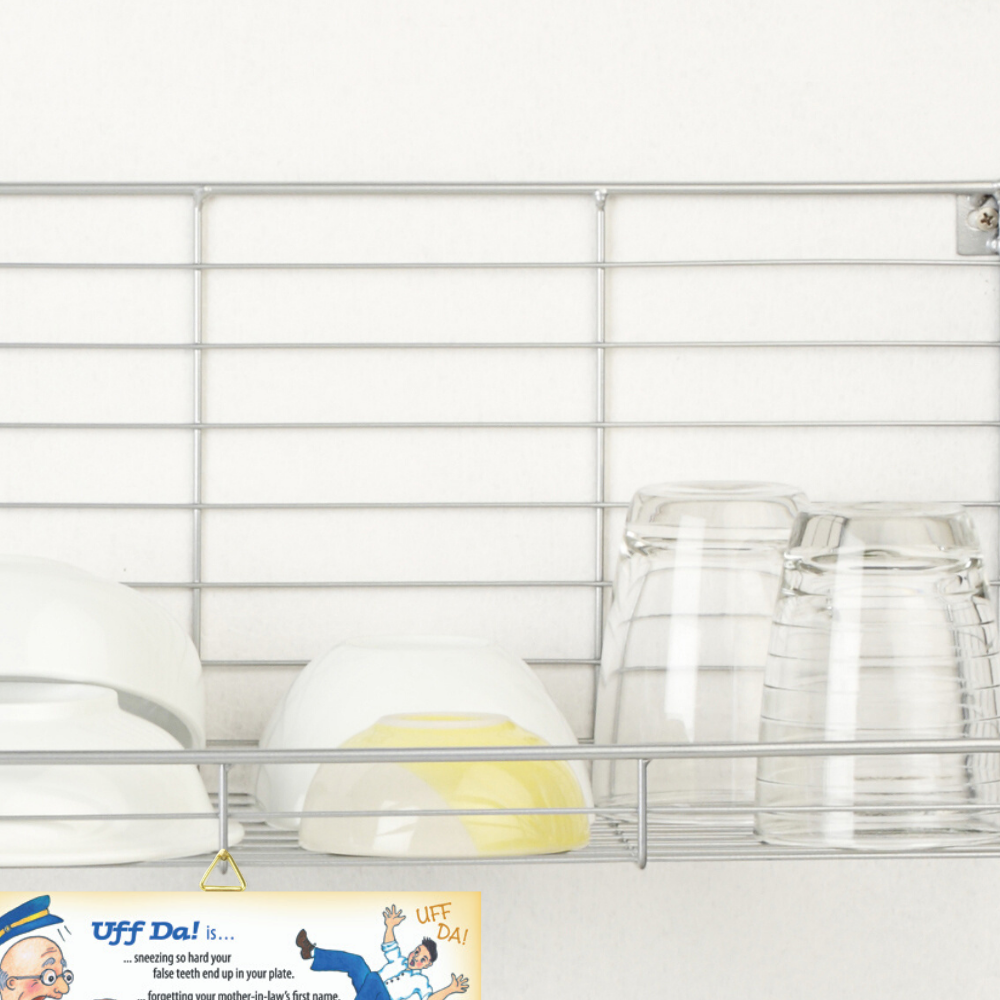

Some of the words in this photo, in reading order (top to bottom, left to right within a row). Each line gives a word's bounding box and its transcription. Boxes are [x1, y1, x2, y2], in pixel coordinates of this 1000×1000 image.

[415, 901, 452, 925] UFF
[91, 920, 146, 946] Uff
[149, 920, 201, 942] Da!
[436, 922, 469, 946] DA!
[133, 951, 175, 966] sneezing
[175, 953, 187, 964] so
[187, 951, 210, 964] hard
[210, 953, 232, 966] your
[152, 966, 175, 980] false
[175, 967, 201, 980] teeth
[201, 967, 220, 980] end
[221, 969, 234, 982] up
[235, 967, 245, 980] in
[245, 969, 268, 982] your
[268, 967, 295, 982] plate.
